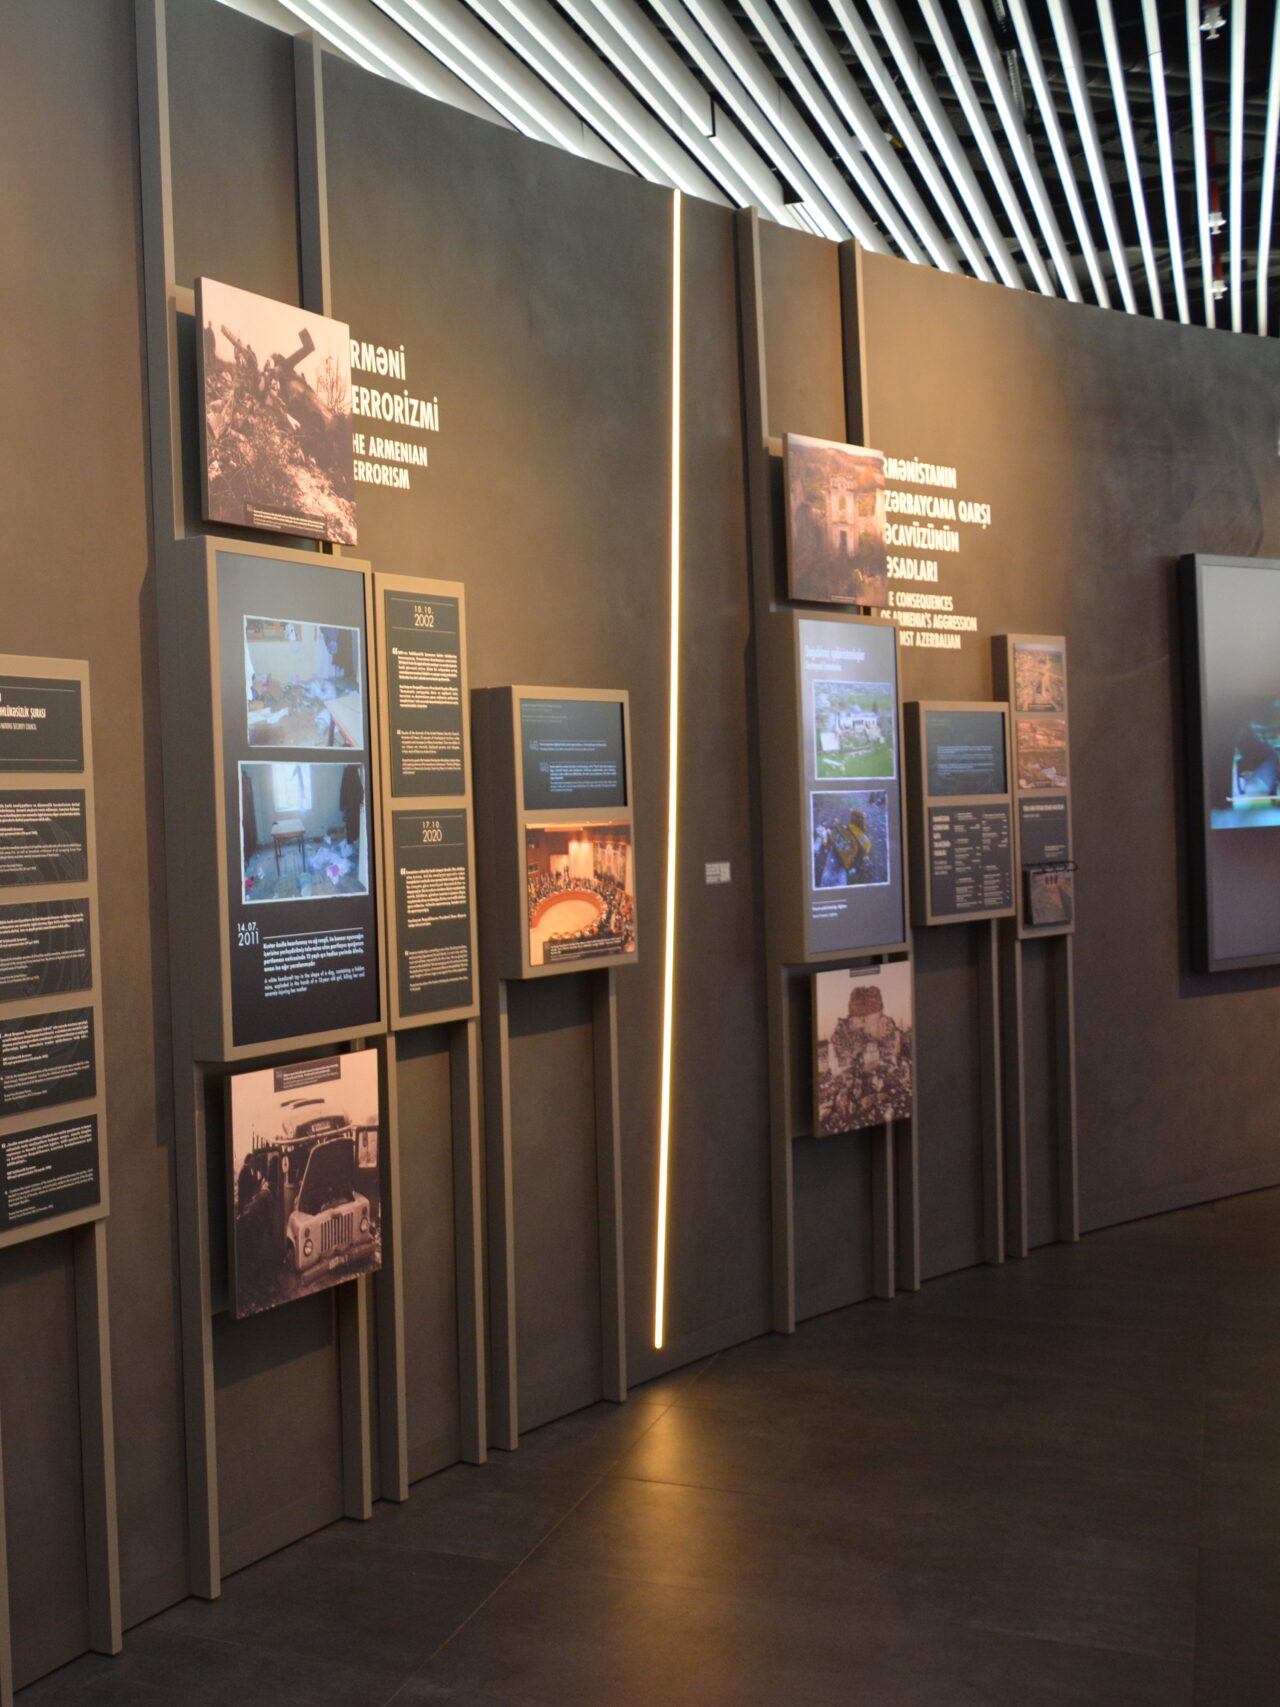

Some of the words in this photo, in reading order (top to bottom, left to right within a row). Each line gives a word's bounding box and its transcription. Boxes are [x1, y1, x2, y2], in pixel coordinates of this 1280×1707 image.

[350, 339, 406, 381] RMƏNİ
[351, 384, 440, 432] ERRORİZMİ
[353, 433, 366, 455] HE
[369, 436, 428, 467] ARMENIAN
[353, 460, 410, 490] ERRORISM
[882, 457, 957, 489] RMƏNİSTANIN
[884, 490, 957, 521] ZƏRBAYCANA
[958, 499, 991, 530] QARŞI
[884, 521, 960, 553] ƏCAVÜZÜNÜN
[886, 555, 938, 582] ƏSADLARI
[414, 605, 436, 615] 10.10.
[896, 591, 954, 612] CONSEQUENCES
[414, 613, 434, 628] 2002
[932, 613, 978, 632] AGGRESSION
[422, 820, 444, 829] 17.10.
[422, 829, 443, 843] 2020
[237, 921, 260, 932] 14.07.
[238, 931, 259, 947] 2011
